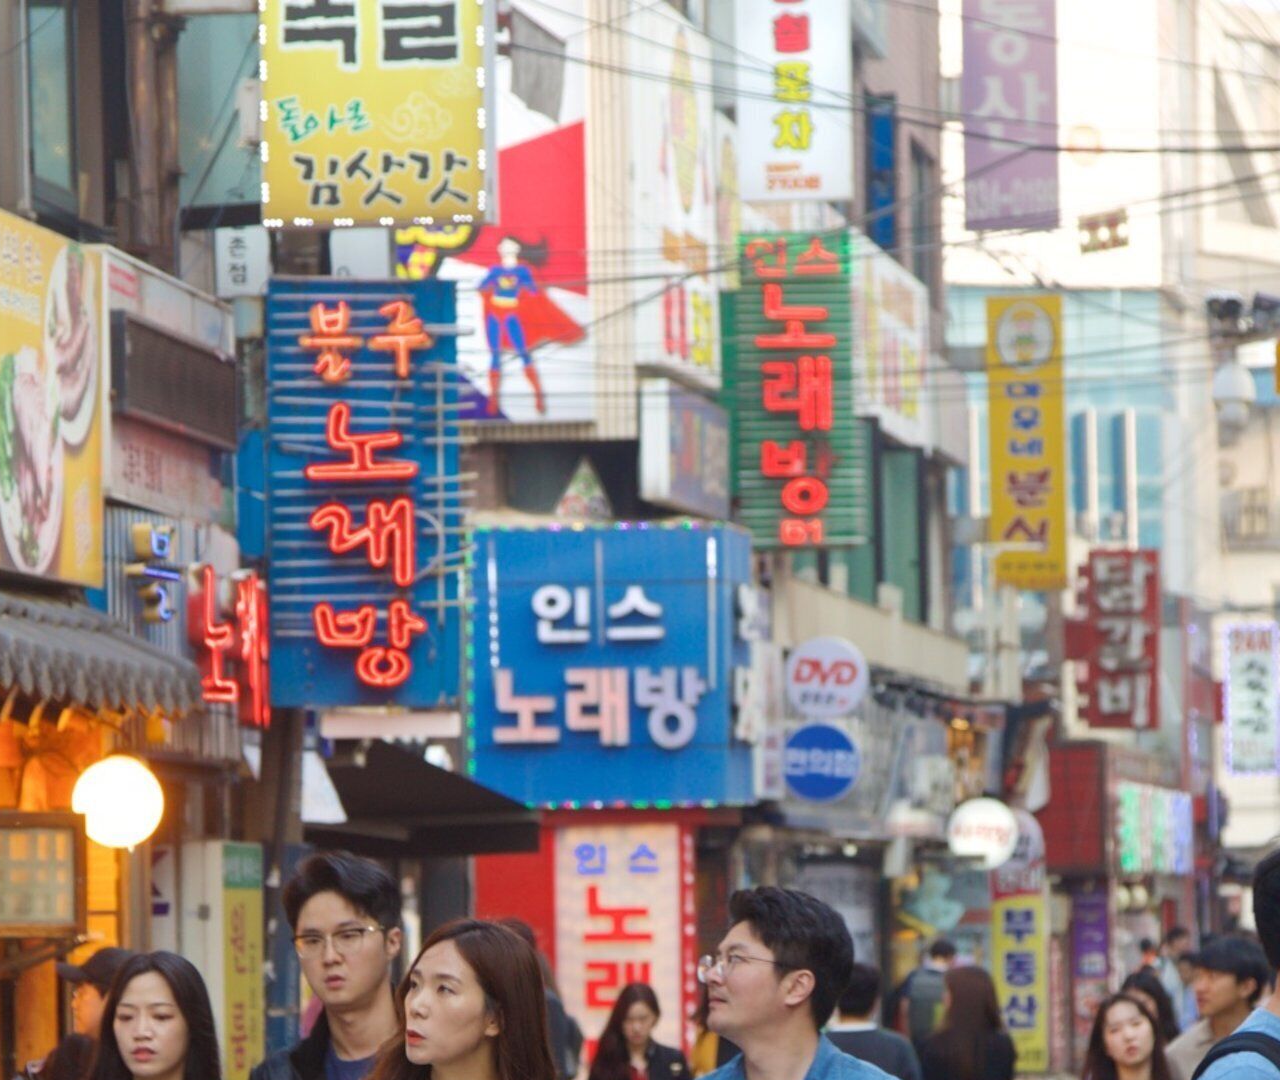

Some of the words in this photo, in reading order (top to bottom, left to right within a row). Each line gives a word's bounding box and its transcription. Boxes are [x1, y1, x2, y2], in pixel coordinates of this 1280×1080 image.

[277, 96, 371, 142] 돌아온
[293, 149, 471, 206] 김삿갓
[745, 236, 842, 279] 인스
[298, 299, 434, 384] 블루
[753, 282, 838, 516] 노래방
[304, 400, 428, 688] 노래방
[531, 584, 667, 646] 인스
[792, 656, 859, 687] DVD
[492, 666, 708, 750] 노래방
[573, 842, 659, 874] 인스
[1003, 907, 1039, 1029] 부동산
